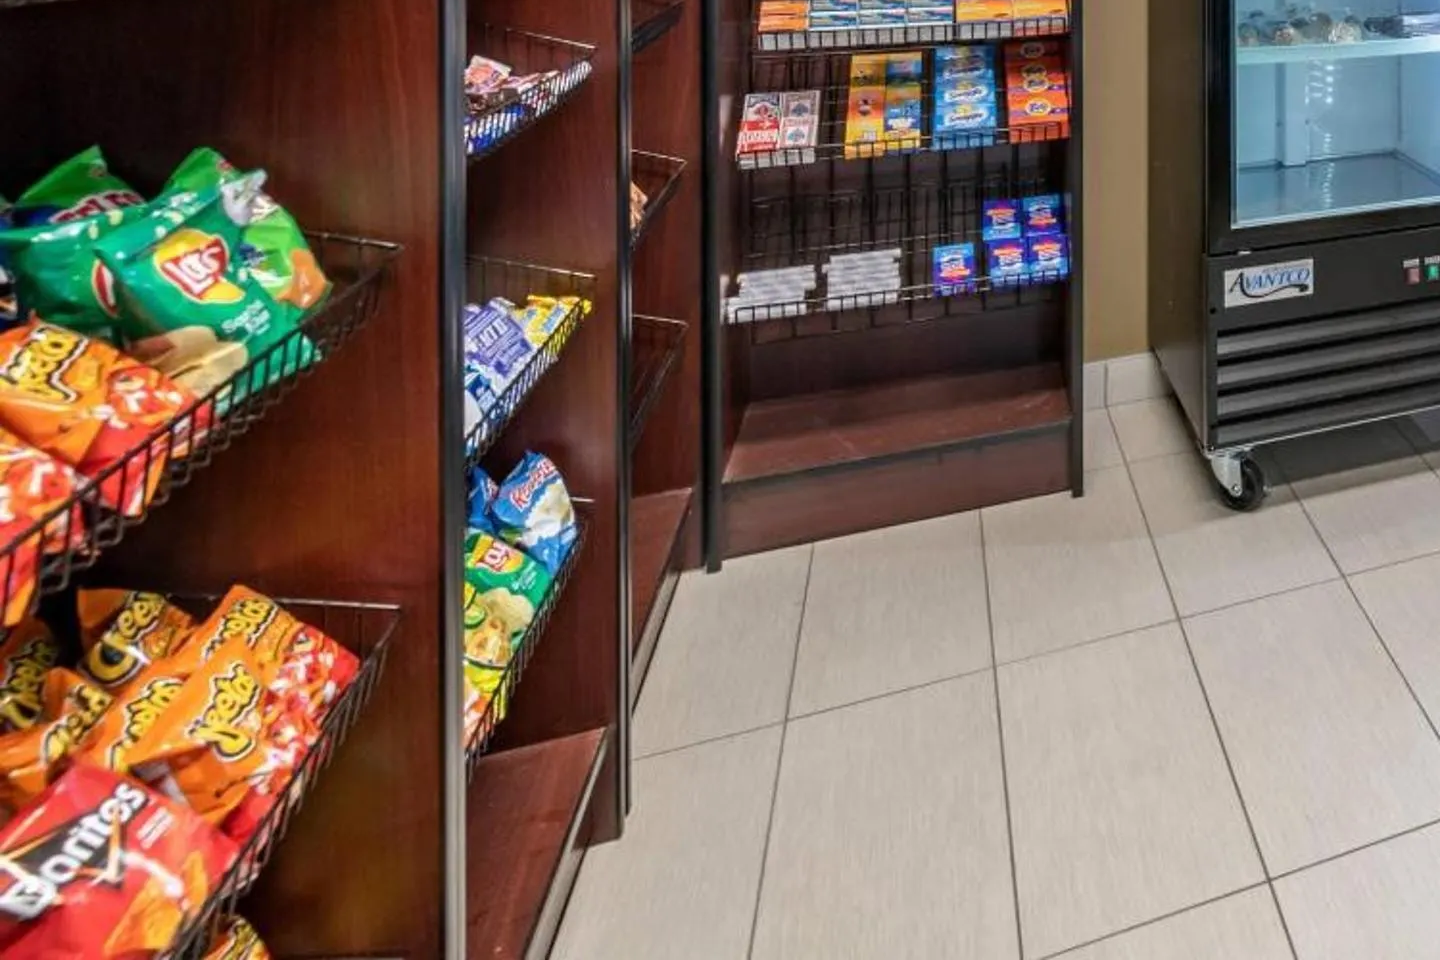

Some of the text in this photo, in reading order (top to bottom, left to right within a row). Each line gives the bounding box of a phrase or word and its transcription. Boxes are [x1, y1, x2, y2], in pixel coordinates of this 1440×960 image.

[161, 245, 223, 295] Lay's
[1229, 268, 1310, 298] AVANTCO
[0, 781, 148, 921] Doritos
